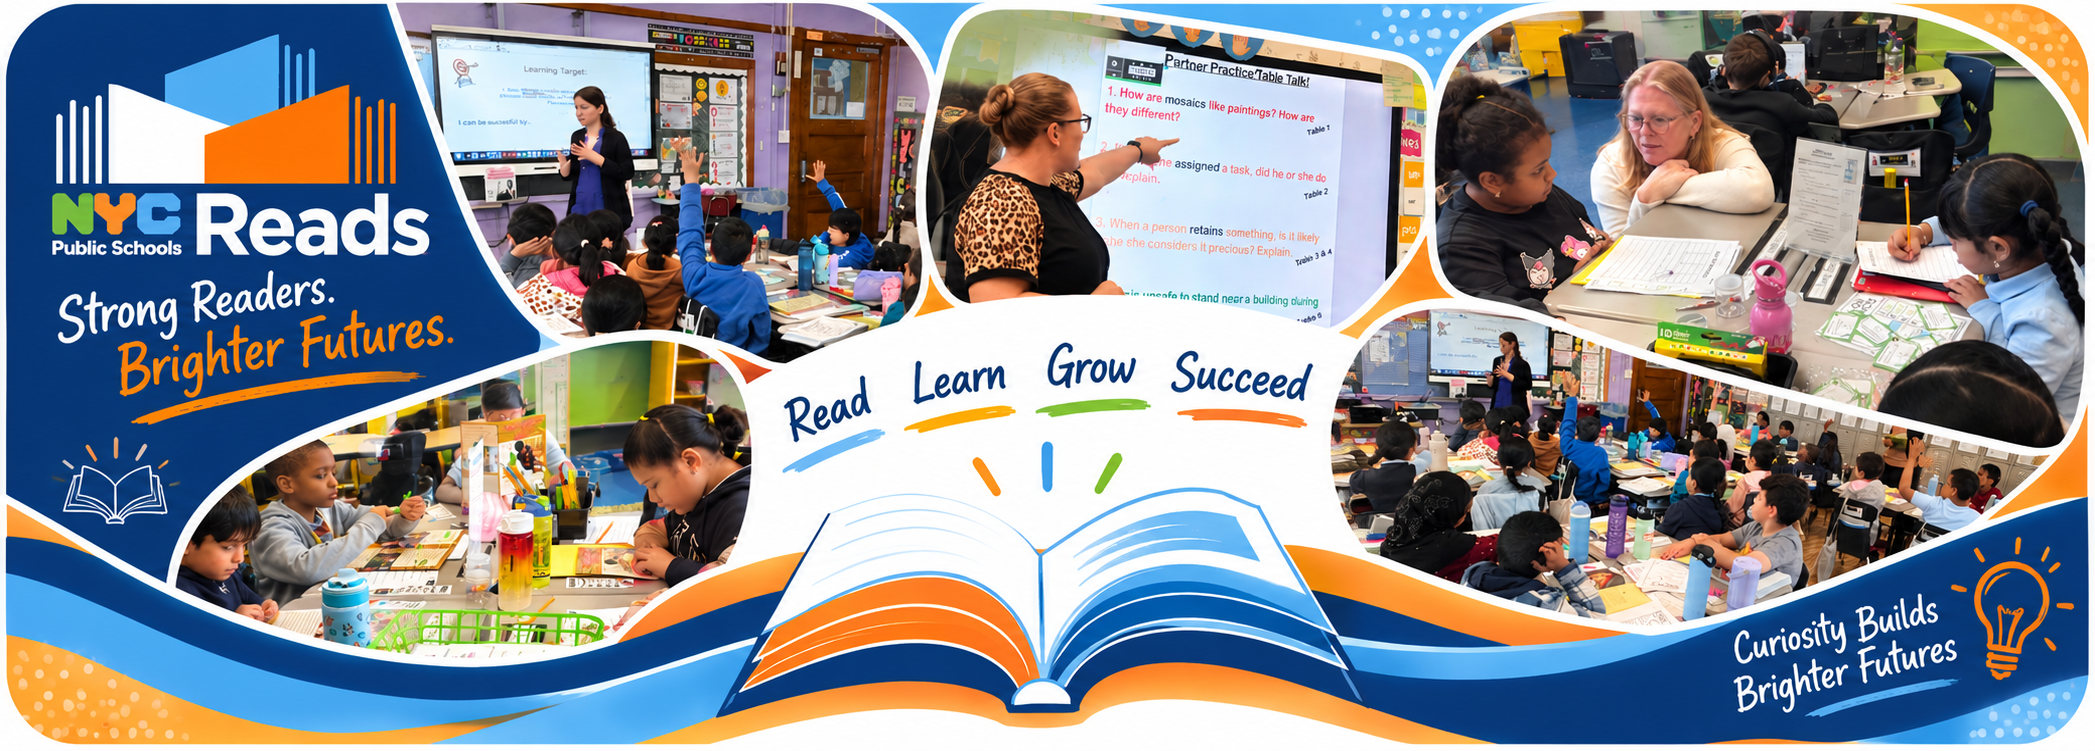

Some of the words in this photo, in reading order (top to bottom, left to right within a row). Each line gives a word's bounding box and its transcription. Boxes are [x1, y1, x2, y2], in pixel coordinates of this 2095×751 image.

[523, 65, 558, 76] Learning
[561, 66, 588, 76] Target:
[1165, 53, 1209, 73] Partner
[1286, 73, 1310, 88] Talk!
[1105, 102, 1129, 118] they
[1131, 106, 1181, 122] different?
[1108, 86, 1117, 97] 1.
[1120, 87, 1144, 100] How
[1146, 92, 1162, 103] are
[1165, 95, 1206, 109] mosaics
[1209, 100, 1226, 112] like
[1227, 104, 1276, 119] paintings?
[1279, 110, 1299, 122] How
[1300, 114, 1315, 123] are
[1307, 126, 1325, 136] Table
[1175, 159, 1220, 173] assigned
[1222, 165, 1228, 174] a
[1230, 164, 1253, 177] task,
[1255, 167, 1271, 178] did
[1272, 168, 1284, 179] he
[1286, 171, 1296, 180] or
[1297, 170, 1314, 181] she
[1315, 172, 1327, 183] do
[52, 192, 181, 235] NYC
[196, 192, 430, 257] Reads
[1095, 216, 1106, 228] 3.
[1110, 217, 1140, 231] When
[1142, 223, 1149, 231] a
[1151, 224, 1187, 234] person
[1189, 224, 1224, 237] retains
[1226, 227, 1276, 242] something,
[1278, 231, 1287, 241] is
[1297, 231, 1320, 245] likely
[52, 240, 107, 256] Public
[111, 240, 182, 256] Schools
[1126, 236, 1145, 248] she
[1147, 240, 1197, 251] considers
[1208, 244, 1254, 256] precious?
[1257, 245, 1293, 258] Explain.
[57, 291, 178, 344] Strong
[191, 270, 335, 323] Readers.
[1191, 292, 1219, 303] stand
[1253, 294, 1288, 308] building
[118, 325, 285, 397] Brighter
[299, 309, 454, 369] Futures.
[783, 376, 871, 442] Read
[913, 361, 1006, 405] Learn
[1047, 342, 1137, 387] Grow
[1170, 350, 1314, 402] Succeed
[1734, 612, 1847, 664] Curiosity
[1855, 593, 1939, 643] Builds
[1733, 658, 1849, 713] Brighter
[1857, 639, 1958, 684] Futures
